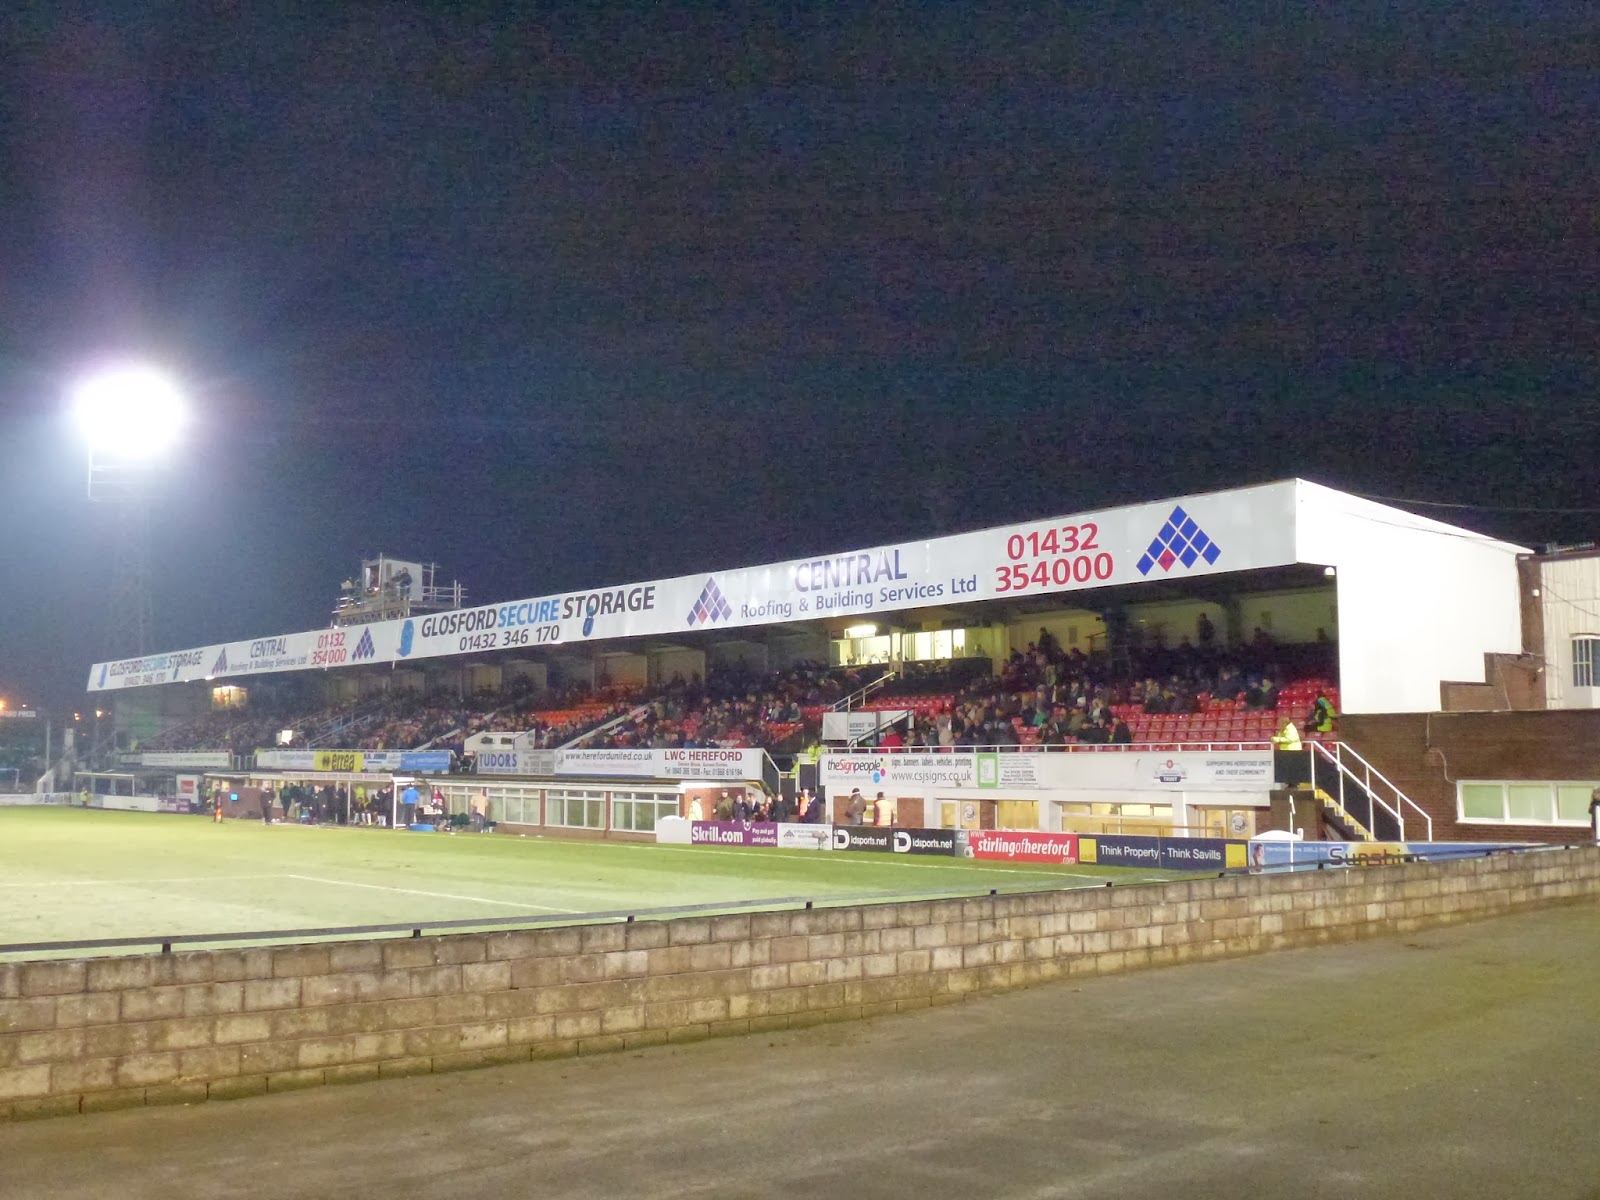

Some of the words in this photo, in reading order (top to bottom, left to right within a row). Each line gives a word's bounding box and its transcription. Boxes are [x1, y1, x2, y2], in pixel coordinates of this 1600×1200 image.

[1007, 522, 1099, 560] 01432
[794, 549, 908, 592] CENTRAL
[995, 552, 1113, 593] 354000
[740, 602, 792, 618] Roofing
[798, 600, 809, 612] &
[815, 590, 873, 612] Building
[880, 582, 944, 602] Services
[951, 575, 977, 594] Ltd
[421, 608, 497, 638] GLOSFORD
[497, 599, 561, 628] SECURE
[562, 586, 656, 619] STORAGE
[459, 631, 496, 651] 01432
[503, 627, 528, 646] 346
[536, 624, 560, 641] 170
[250, 637, 287, 658] CENTRAL
[311, 648, 347, 665] 354000
[110, 660, 142, 677] GLOSFORD
[168, 651, 204, 669] STORAGE
[332, 754, 355, 770] errea
[479, 754, 517, 767] TUDORS
[565, 751, 653, 761] www.herefordunited.co.uk
[664, 751, 686, 760] LWC
[688, 751, 743, 761] HEREFORD
[891, 770, 972, 783] www.csjsigns.co.uk
[692, 826, 743, 843] Skrill.com
[913, 838, 953, 849] idsports.net
[978, 837, 1070, 856] stirlingofhereford
[1100, 845, 1122, 855] Think
[1124, 846, 1158, 859] Property
[1167, 847, 1191, 858] Think
[1193, 849, 1221, 860] Savills
